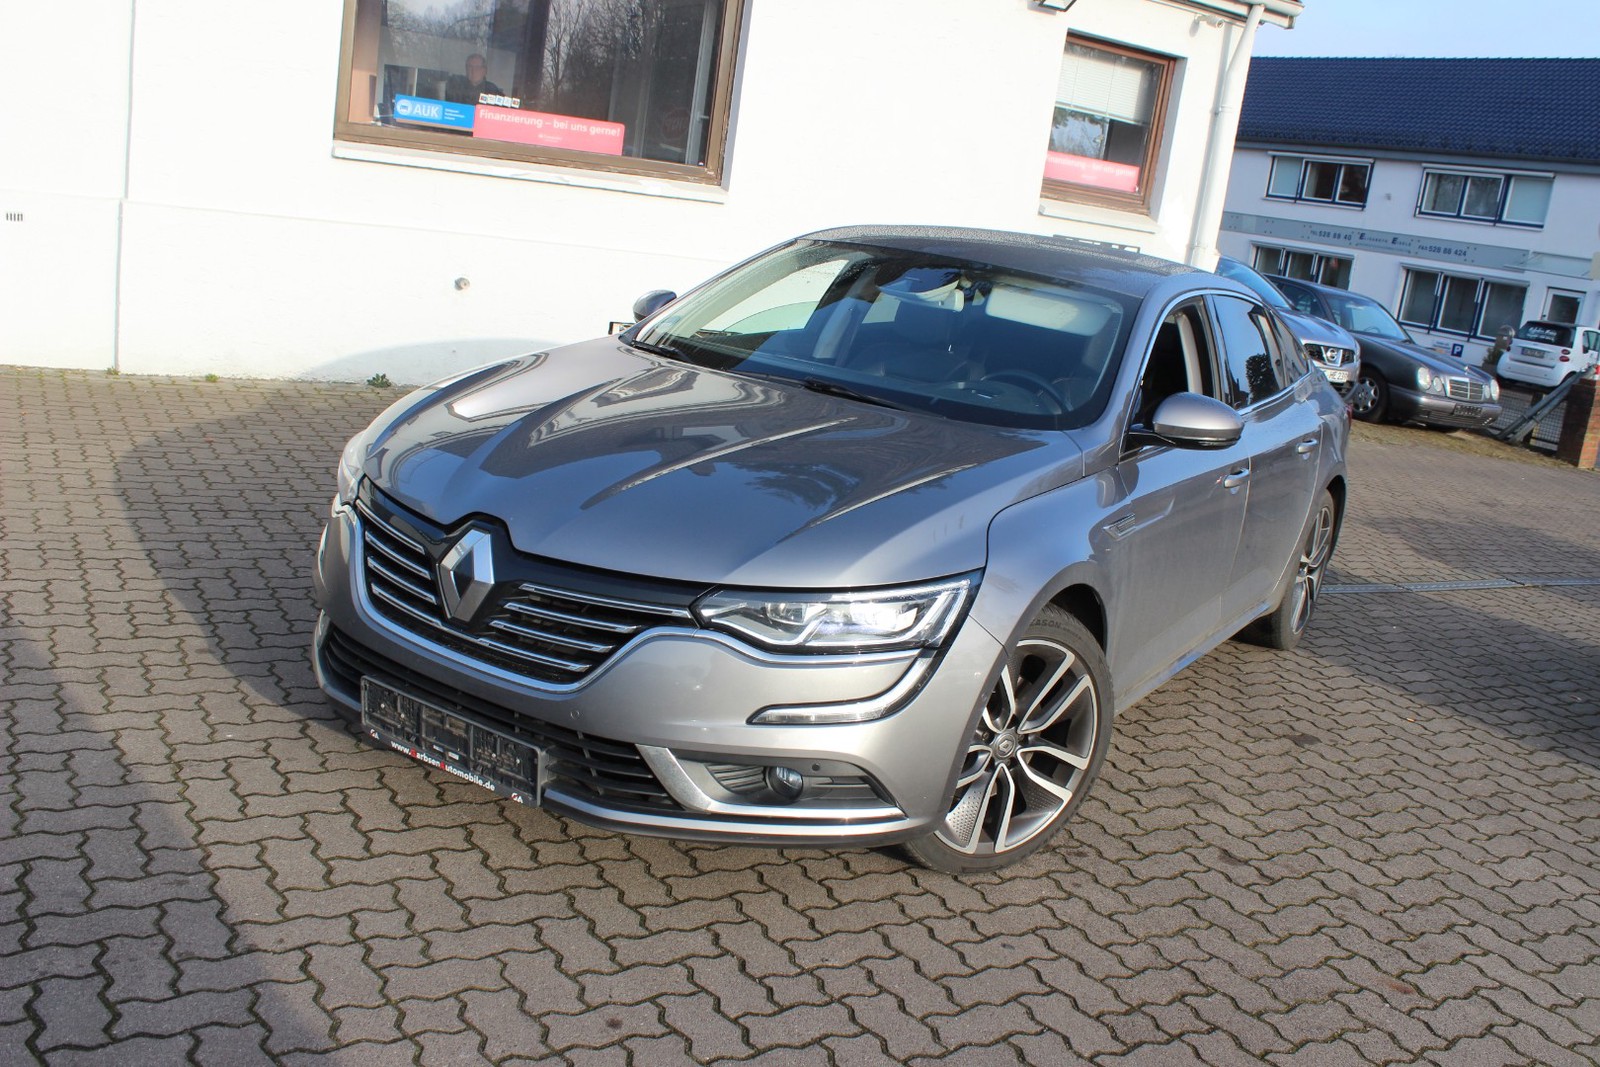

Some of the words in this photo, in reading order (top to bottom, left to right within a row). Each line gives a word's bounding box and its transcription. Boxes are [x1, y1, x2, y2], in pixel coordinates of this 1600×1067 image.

[479, 109, 543, 128] Finanzierung
[553, 119, 568, 129] bei
[571, 123, 588, 132] uns
[589, 125, 621, 137] gerne!
[1454, 248, 1467, 257] 424
